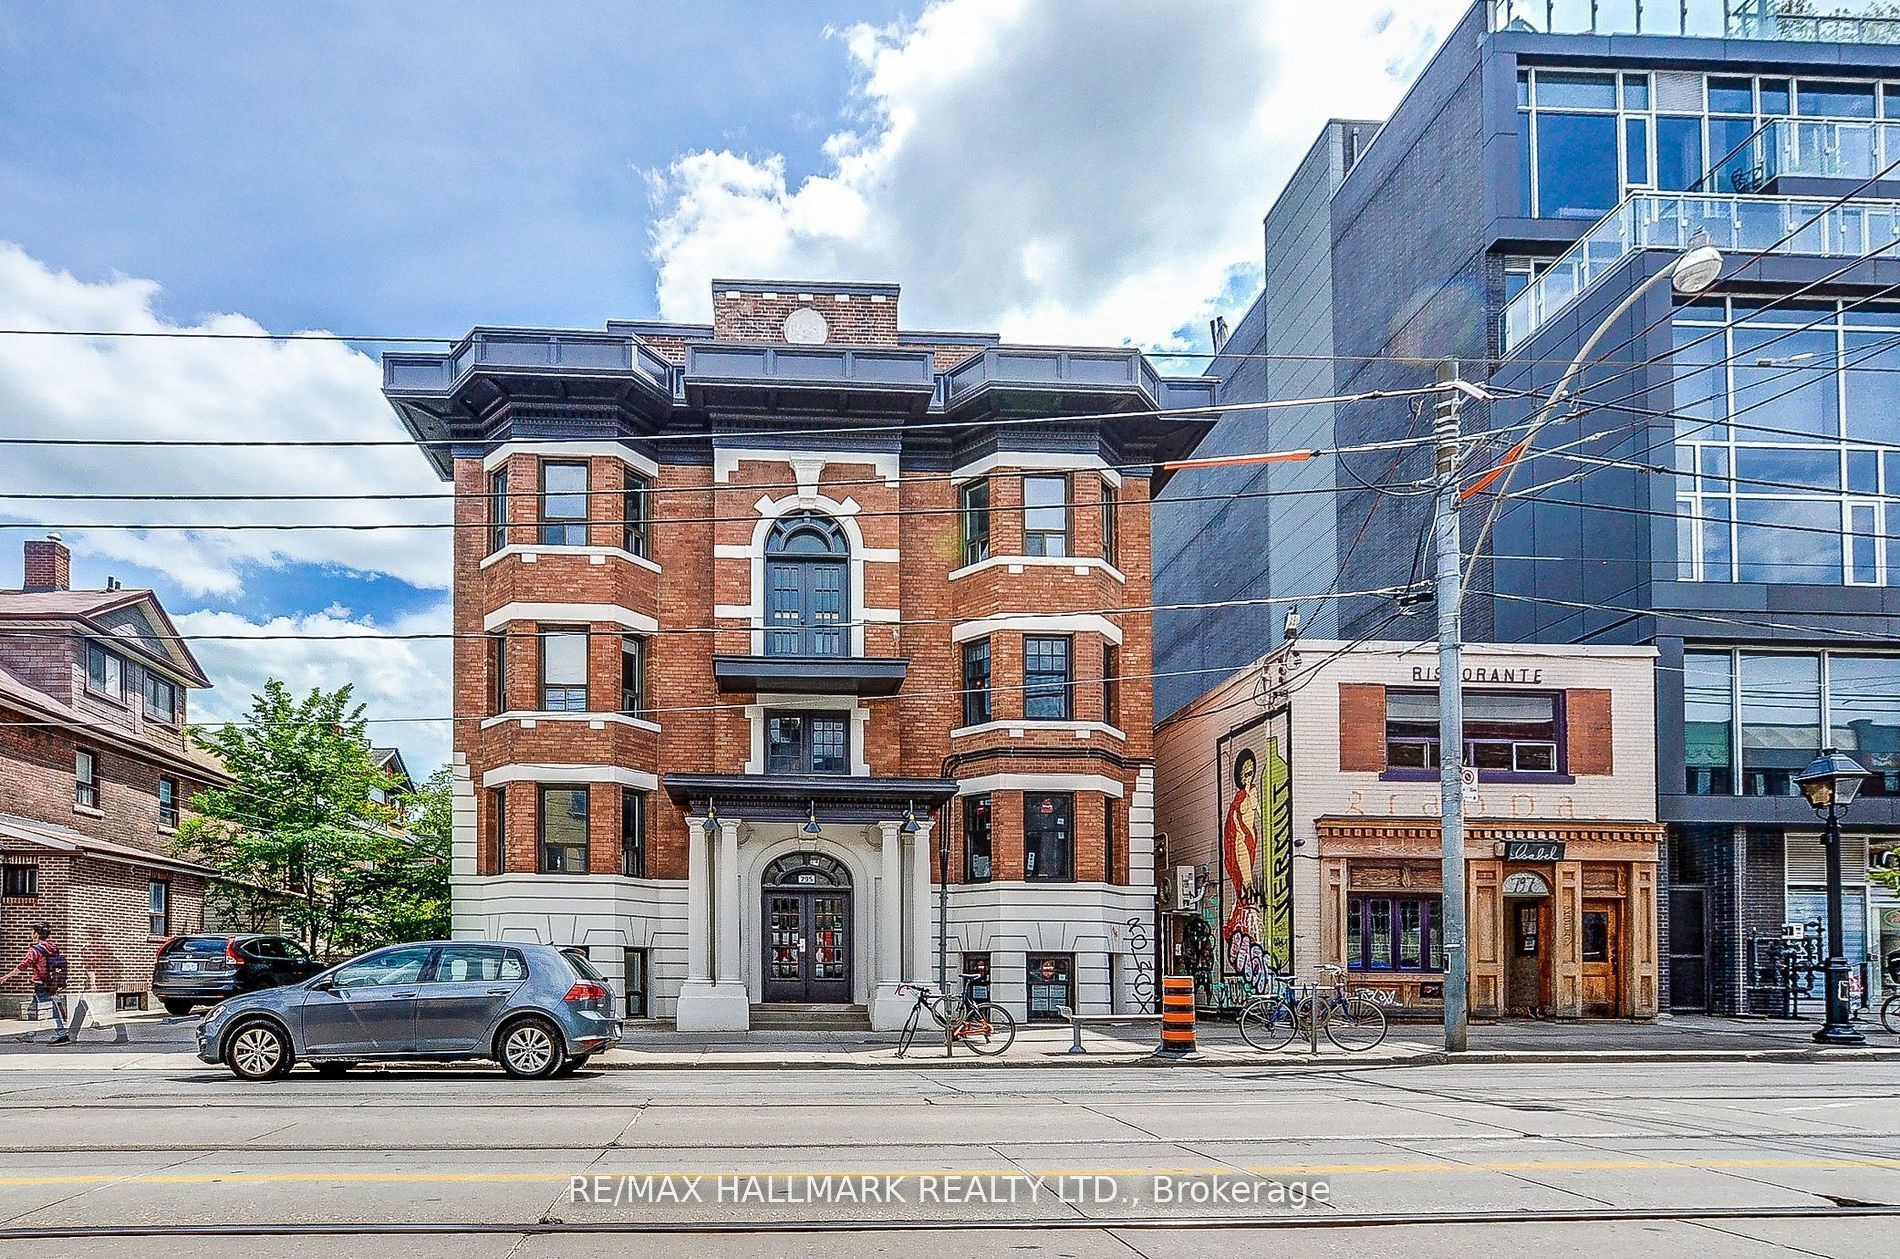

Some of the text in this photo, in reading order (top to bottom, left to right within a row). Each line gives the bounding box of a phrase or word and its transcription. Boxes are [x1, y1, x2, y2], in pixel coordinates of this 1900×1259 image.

[1413, 666, 1542, 684] RISORANTE
[1273, 783, 1291, 926] VERMUT
[1508, 843, 1559, 861] Isabel
